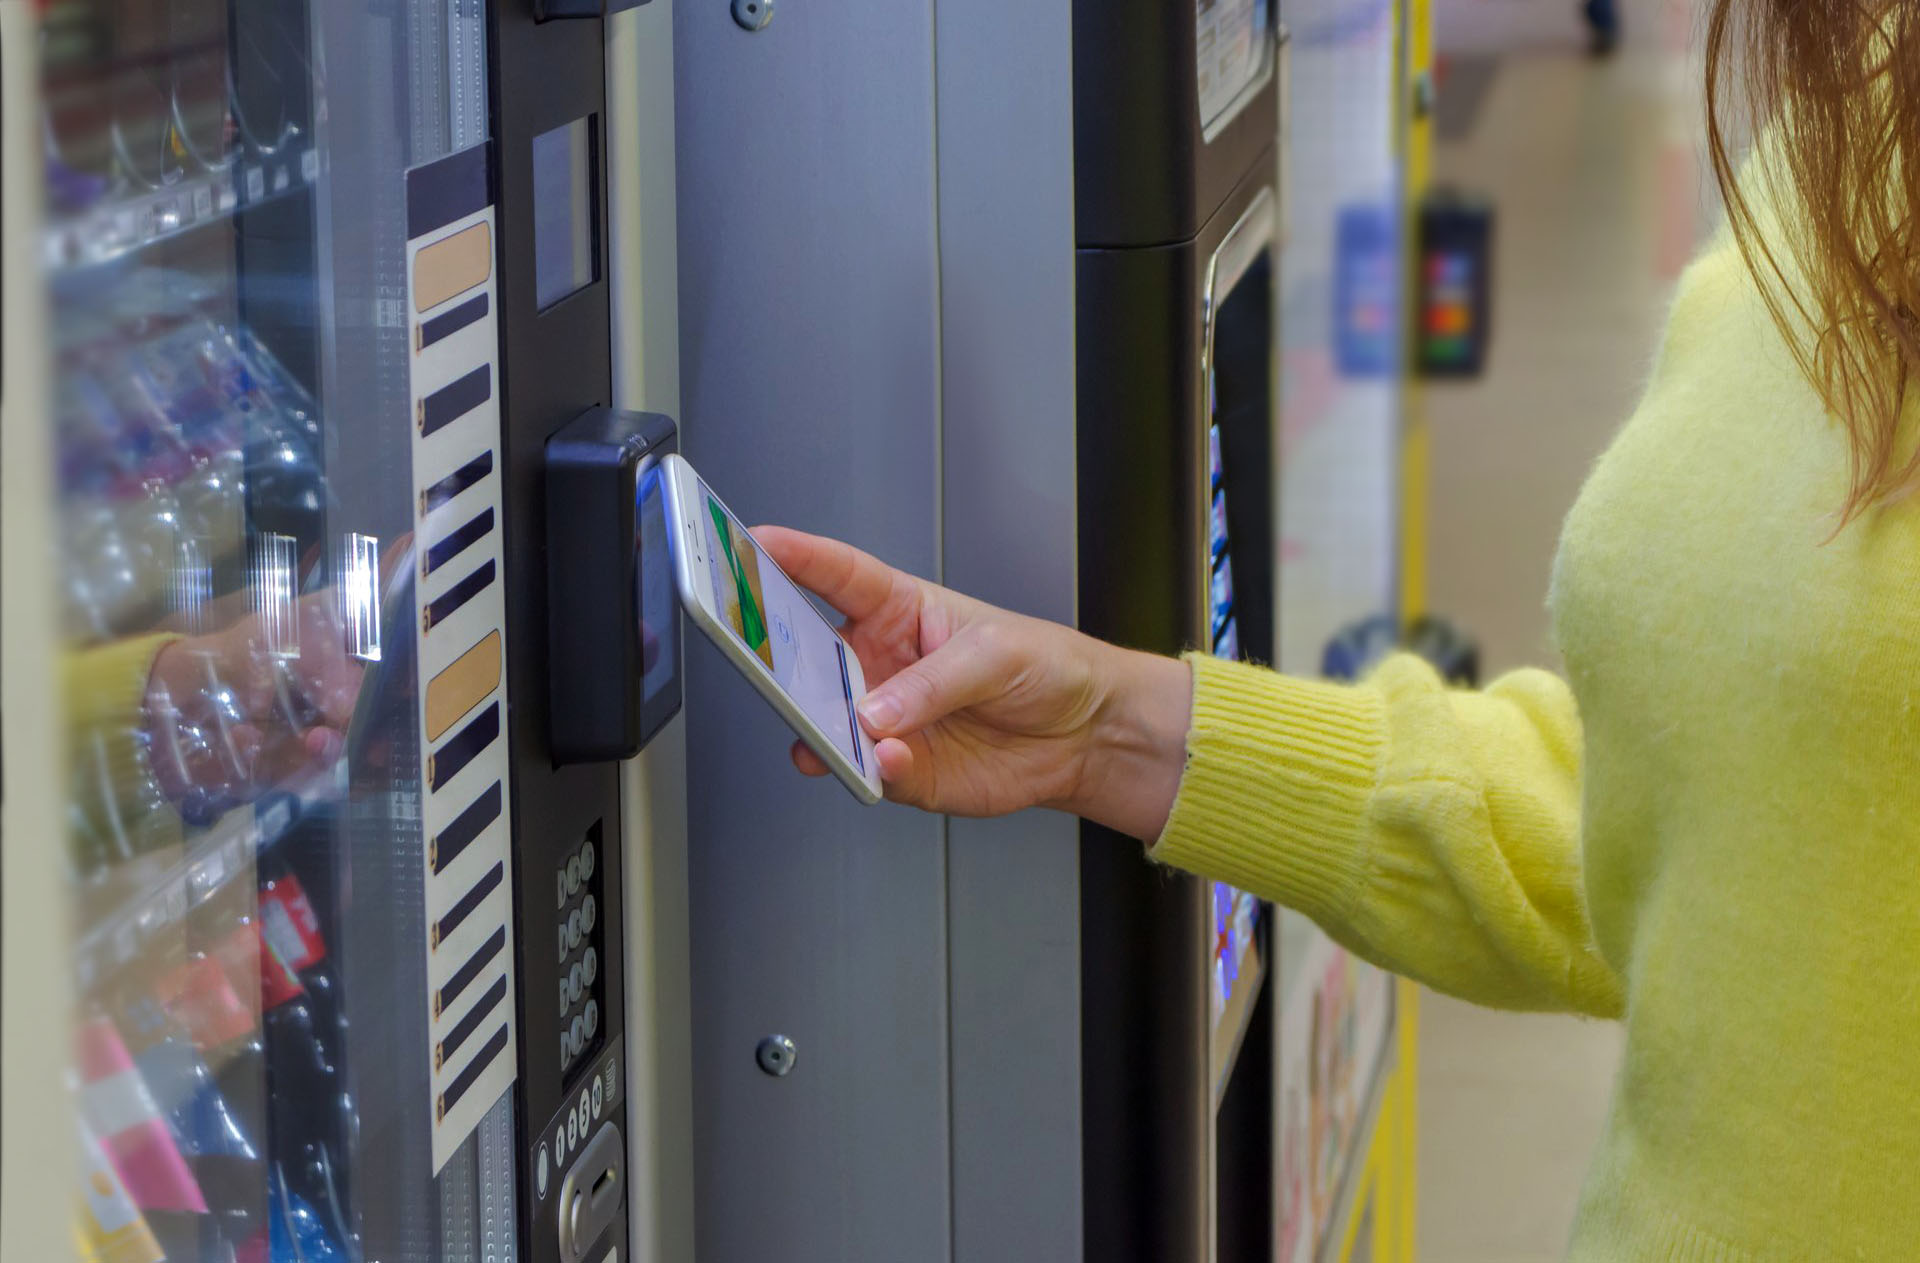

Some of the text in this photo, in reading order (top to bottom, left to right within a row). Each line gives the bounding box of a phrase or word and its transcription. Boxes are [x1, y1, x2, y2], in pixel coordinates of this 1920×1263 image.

[558, 1087, 600, 1158] 1 2 5 10
